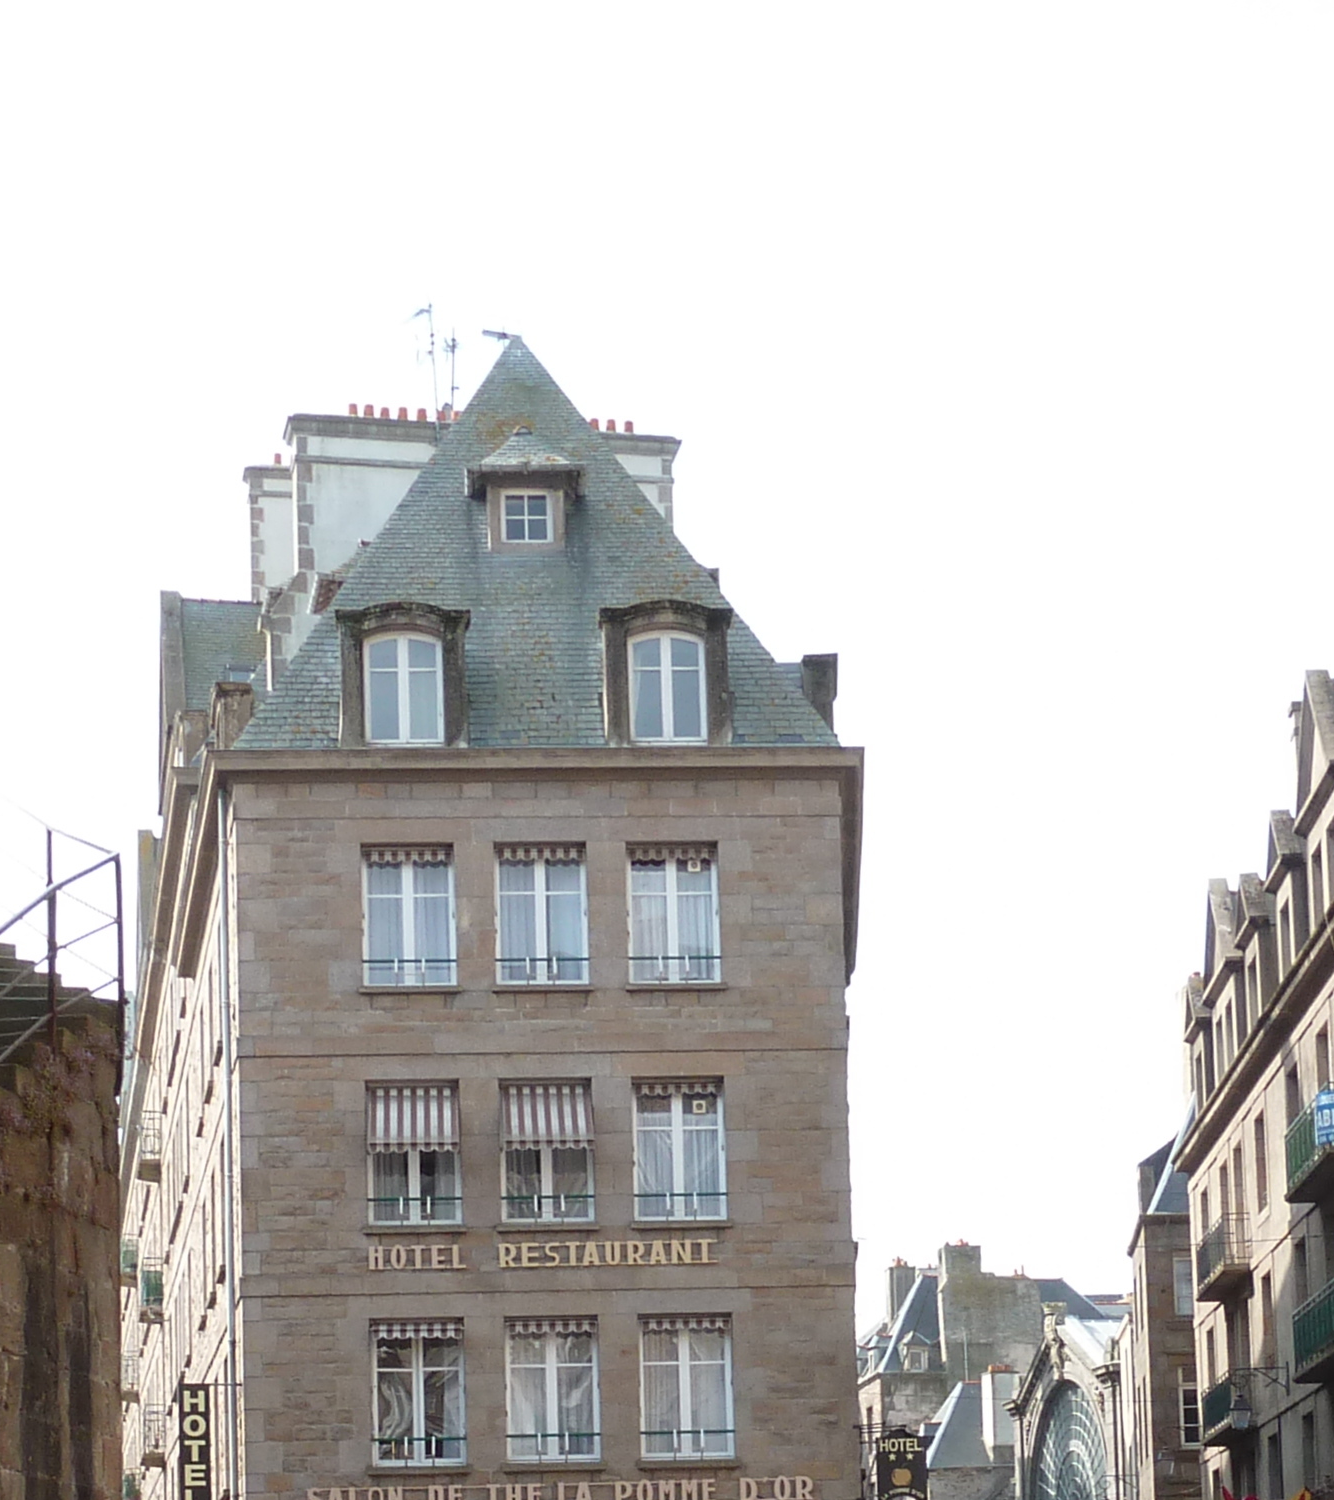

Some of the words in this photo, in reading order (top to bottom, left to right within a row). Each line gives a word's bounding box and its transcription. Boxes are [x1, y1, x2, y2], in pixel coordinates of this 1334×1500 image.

[368, 1245, 466, 1270] HOTEL
[498, 1238, 718, 1268] RESTAURANT
[879, 1438, 922, 1452] HOTEL
